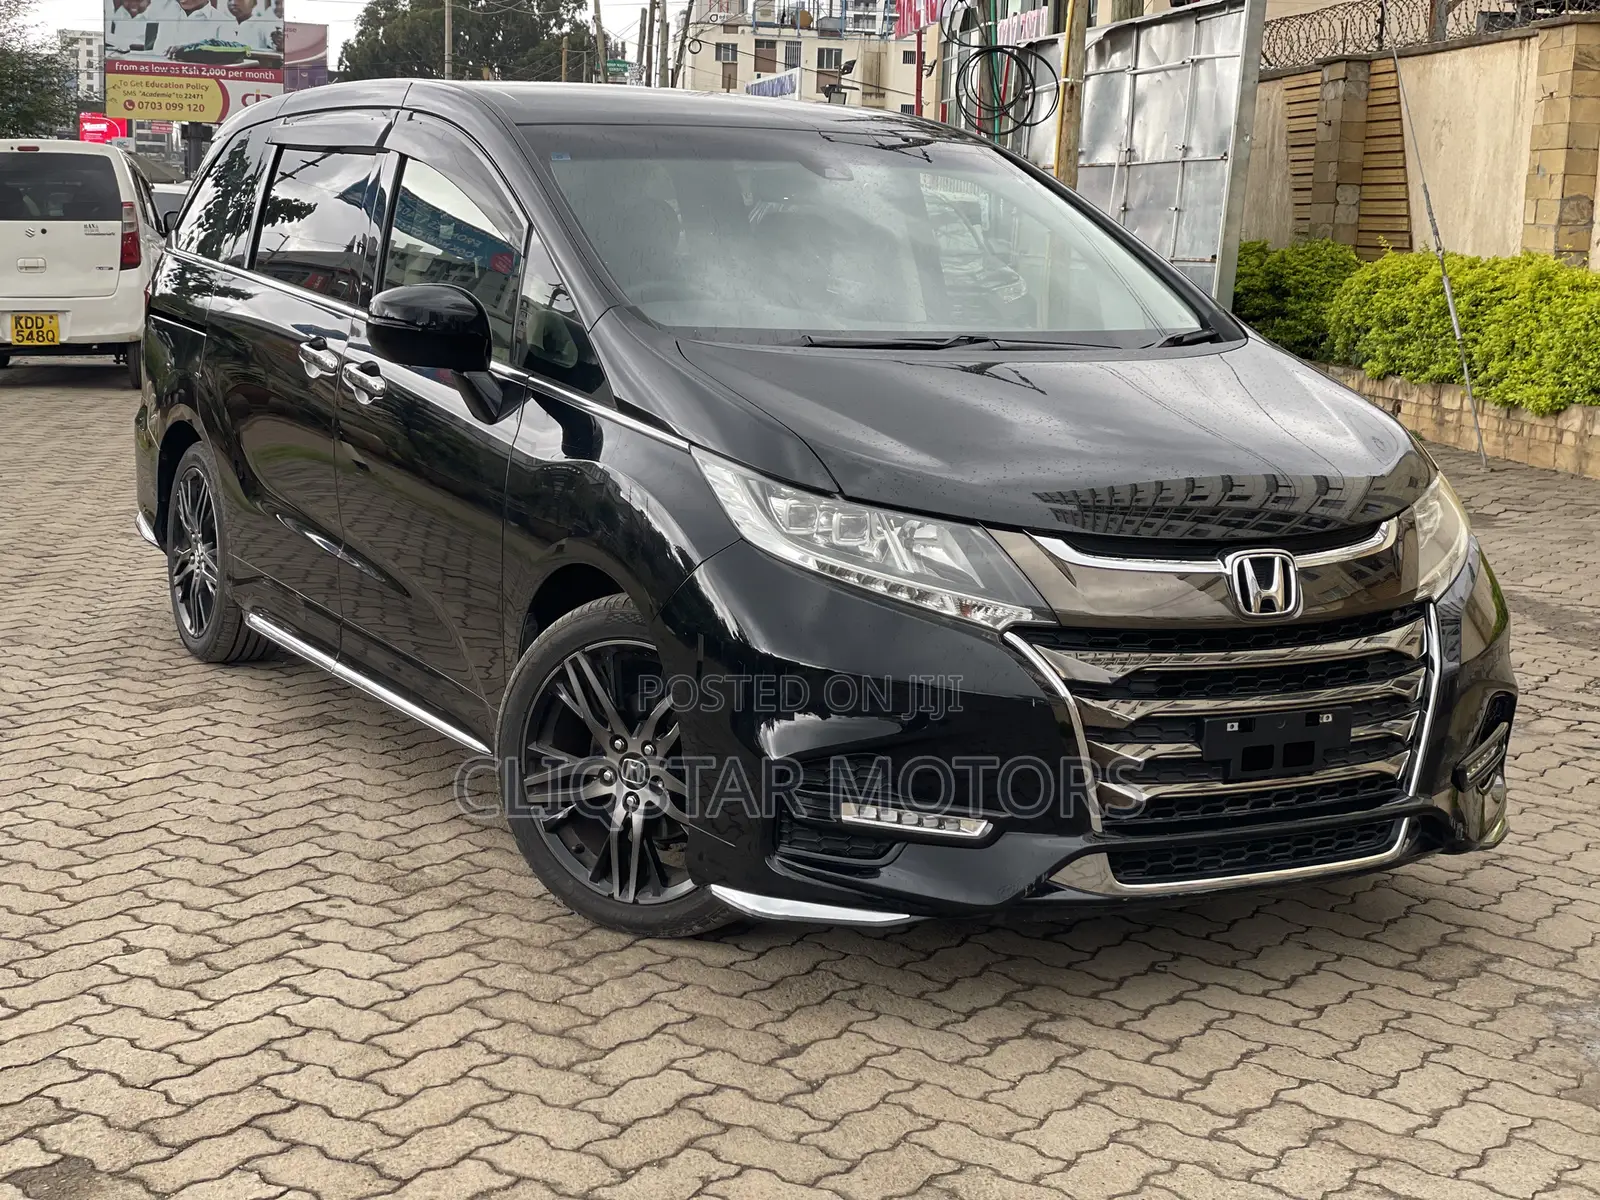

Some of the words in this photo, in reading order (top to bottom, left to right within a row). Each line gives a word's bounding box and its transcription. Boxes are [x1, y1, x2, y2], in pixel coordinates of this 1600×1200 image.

[115, 62, 138, 71] from
[151, 63, 168, 73] low
[182, 66, 199, 75] Ksh
[201, 67, 226, 77] 2,000
[228, 70, 244, 79] per
[245, 71, 275, 80] month
[119, 79, 129, 88] To
[130, 80, 144, 88] Get
[145, 80, 184, 89] Education
[186, 82, 209, 92] Policy
[122, 89, 137, 97] SMS
[176, 91, 183, 99] to
[184, 92, 204, 100] 22471
[137, 101, 163, 111] 0703
[165, 102, 184, 111] 099
[187, 103, 205, 112] 120
[14, 315, 45, 330] KDD
[15, 329, 56, 343] 548Q
